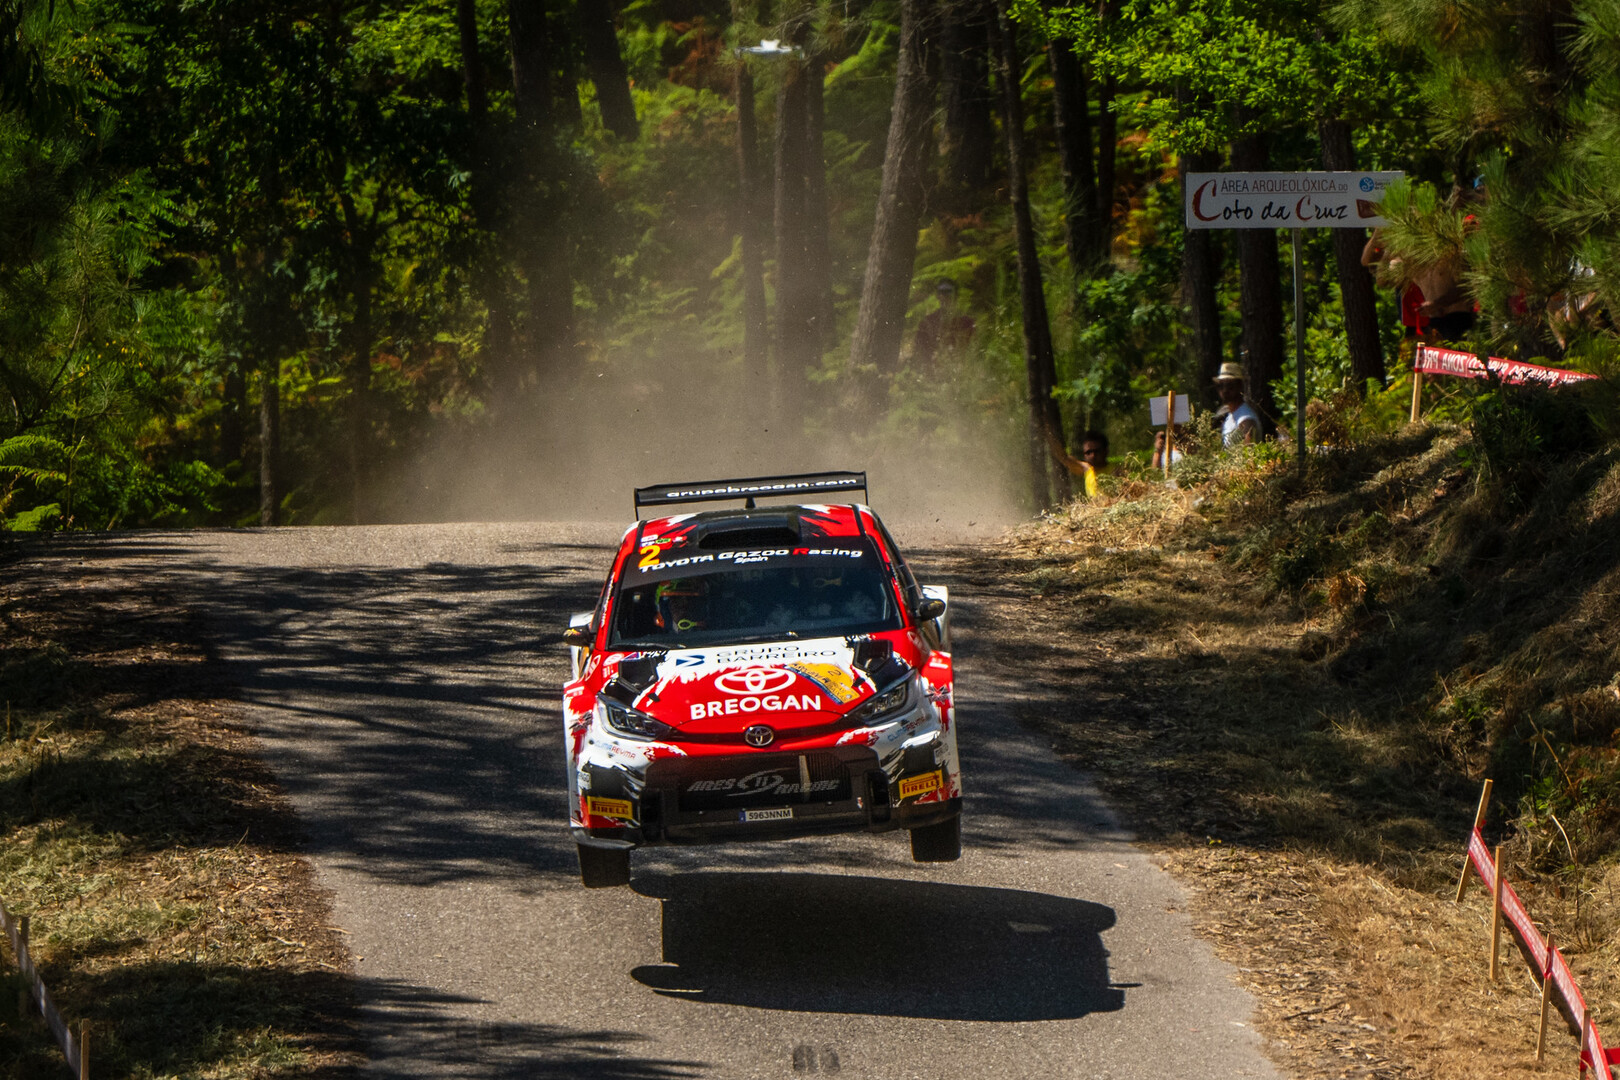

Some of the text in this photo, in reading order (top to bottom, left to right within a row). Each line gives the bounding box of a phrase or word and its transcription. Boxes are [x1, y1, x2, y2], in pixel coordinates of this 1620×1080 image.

[1220, 177, 1349, 193] ÁREA ARQUEOLÓXICA DO
[1192, 179, 1348, 222] Coto da Cruz
[638, 544, 661, 568] 2
[638, 547, 863, 573] TOYOTA GAZOO Racing
[733, 555, 768, 564] Spain
[716, 645, 800, 658] GRUPO
[716, 650, 837, 664] BARREIRO
[690, 695, 822, 720] BREOGAN
[902, 774, 941, 795] PIRELLI
[748, 809, 791, 820] 5963NNM
